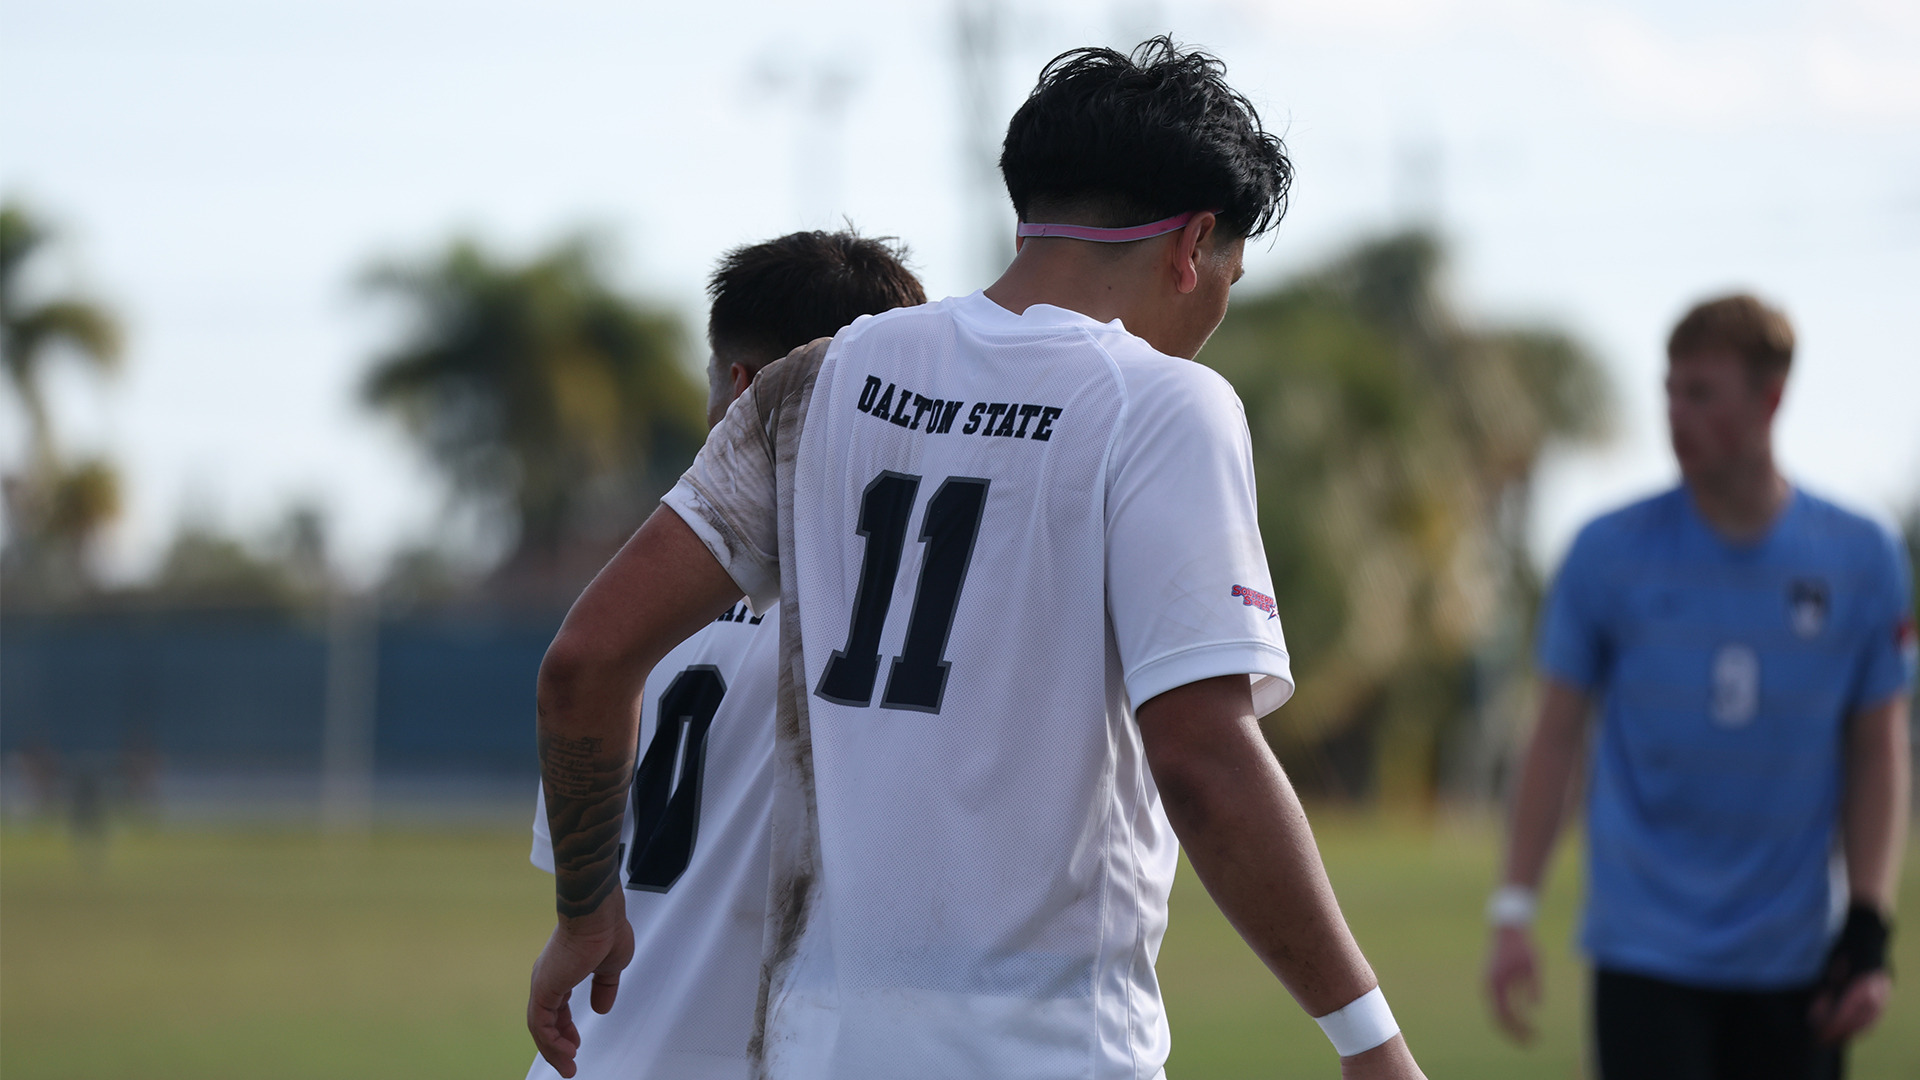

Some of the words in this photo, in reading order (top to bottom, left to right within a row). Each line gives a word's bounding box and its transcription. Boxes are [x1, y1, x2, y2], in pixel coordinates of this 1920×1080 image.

[857, 374, 964, 435] DALTON
[962, 401, 1064, 442] STATE
[813, 469, 991, 715] 11
[619, 664, 728, 894] 0
